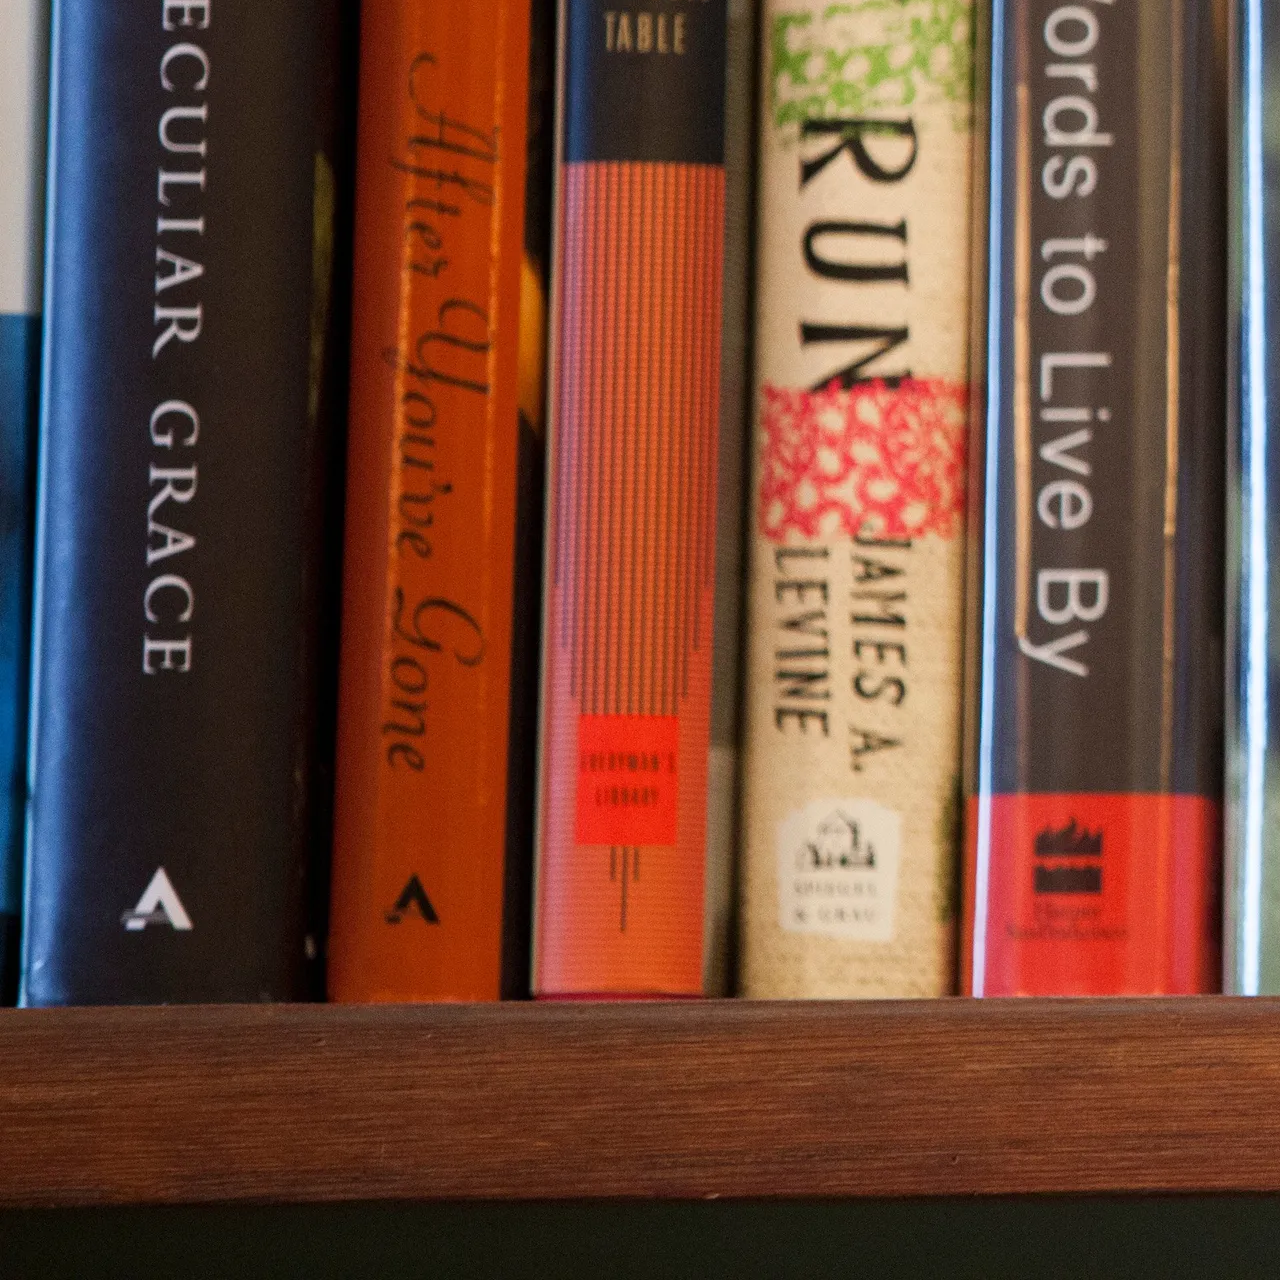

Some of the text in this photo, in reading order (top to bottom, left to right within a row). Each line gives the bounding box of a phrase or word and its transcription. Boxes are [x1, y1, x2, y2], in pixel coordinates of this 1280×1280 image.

[603, 11, 687, 55] TABLE
[800, 116, 920, 393] RUN
[1040, 231, 1108, 317] to
[382, 52, 500, 772] After You've Gone
[1037, 351, 1113, 531] Live
[143, 399, 200, 675] GRACE
[1016, 567, 1110, 679] By
[774, 545, 830, 738] LEVINE
[848, 523, 912, 773] JAMES A.
